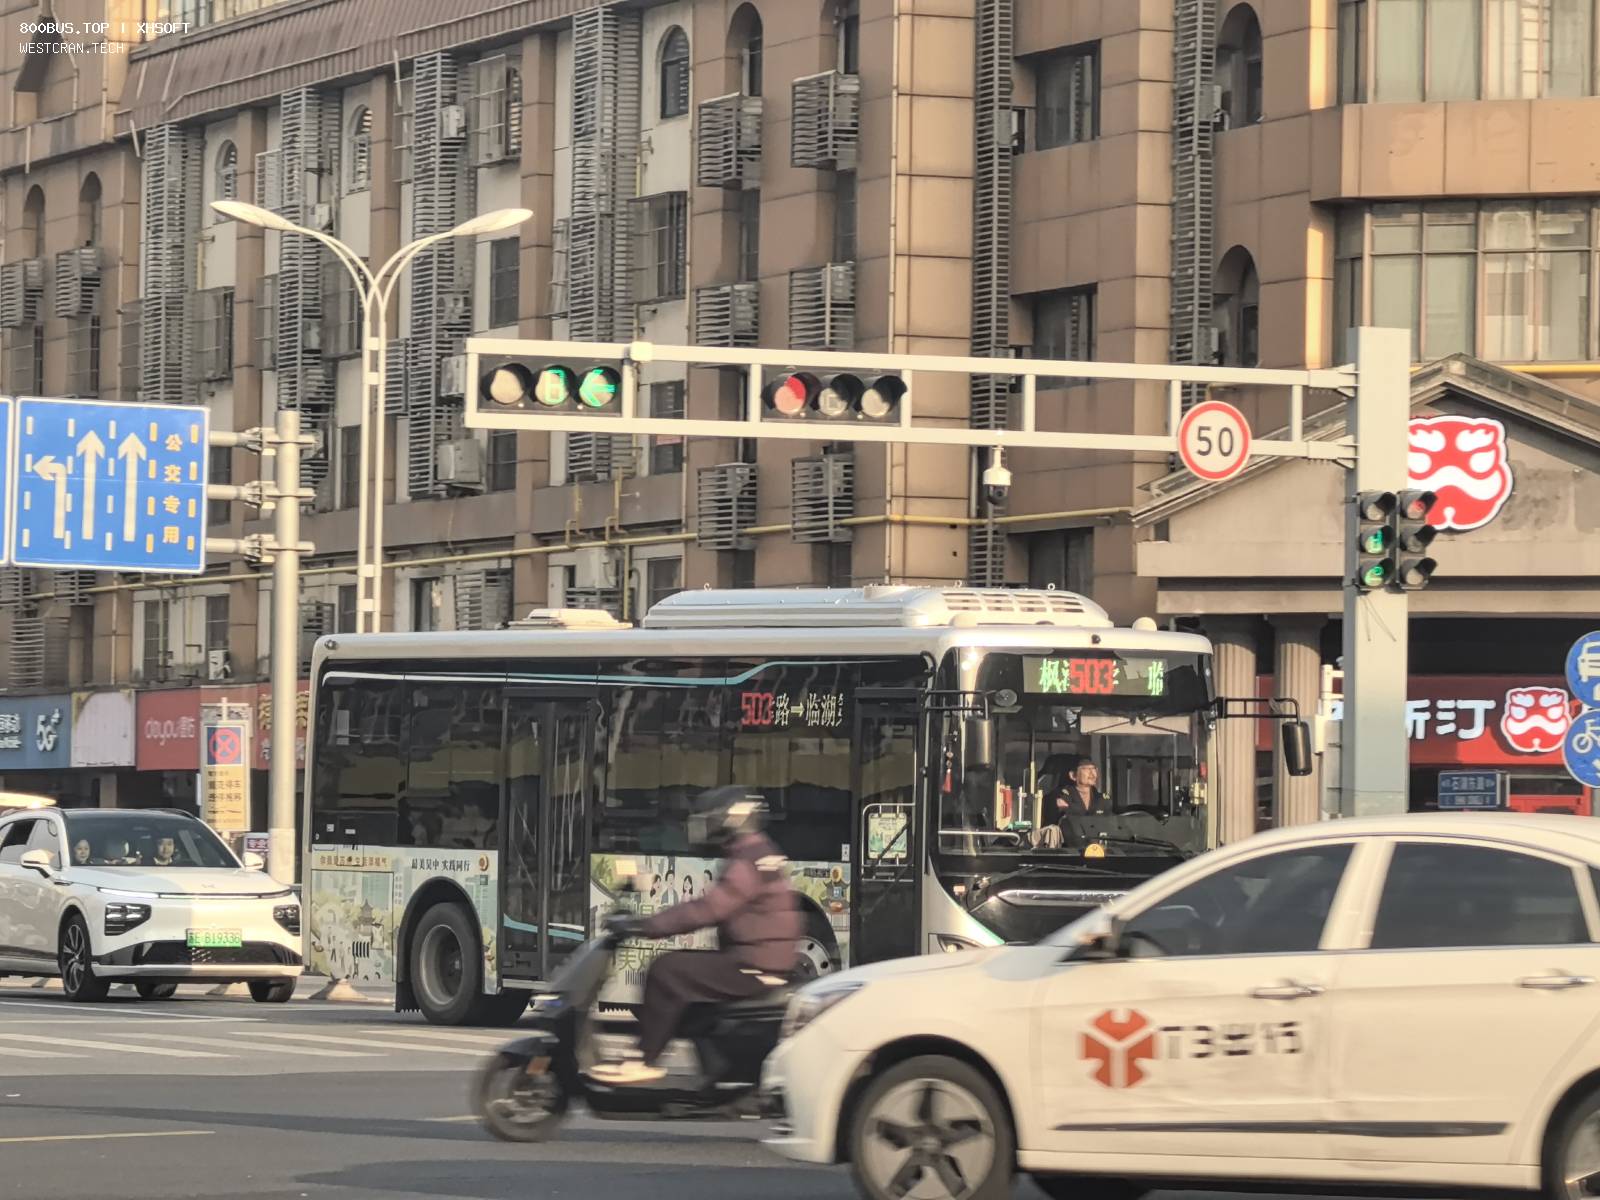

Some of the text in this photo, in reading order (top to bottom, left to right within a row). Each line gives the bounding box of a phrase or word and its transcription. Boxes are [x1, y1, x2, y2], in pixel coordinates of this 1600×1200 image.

[1196, 425, 1234, 457] 50
[162, 433, 183, 543] 公交专用
[1069, 657, 1115, 695] 503
